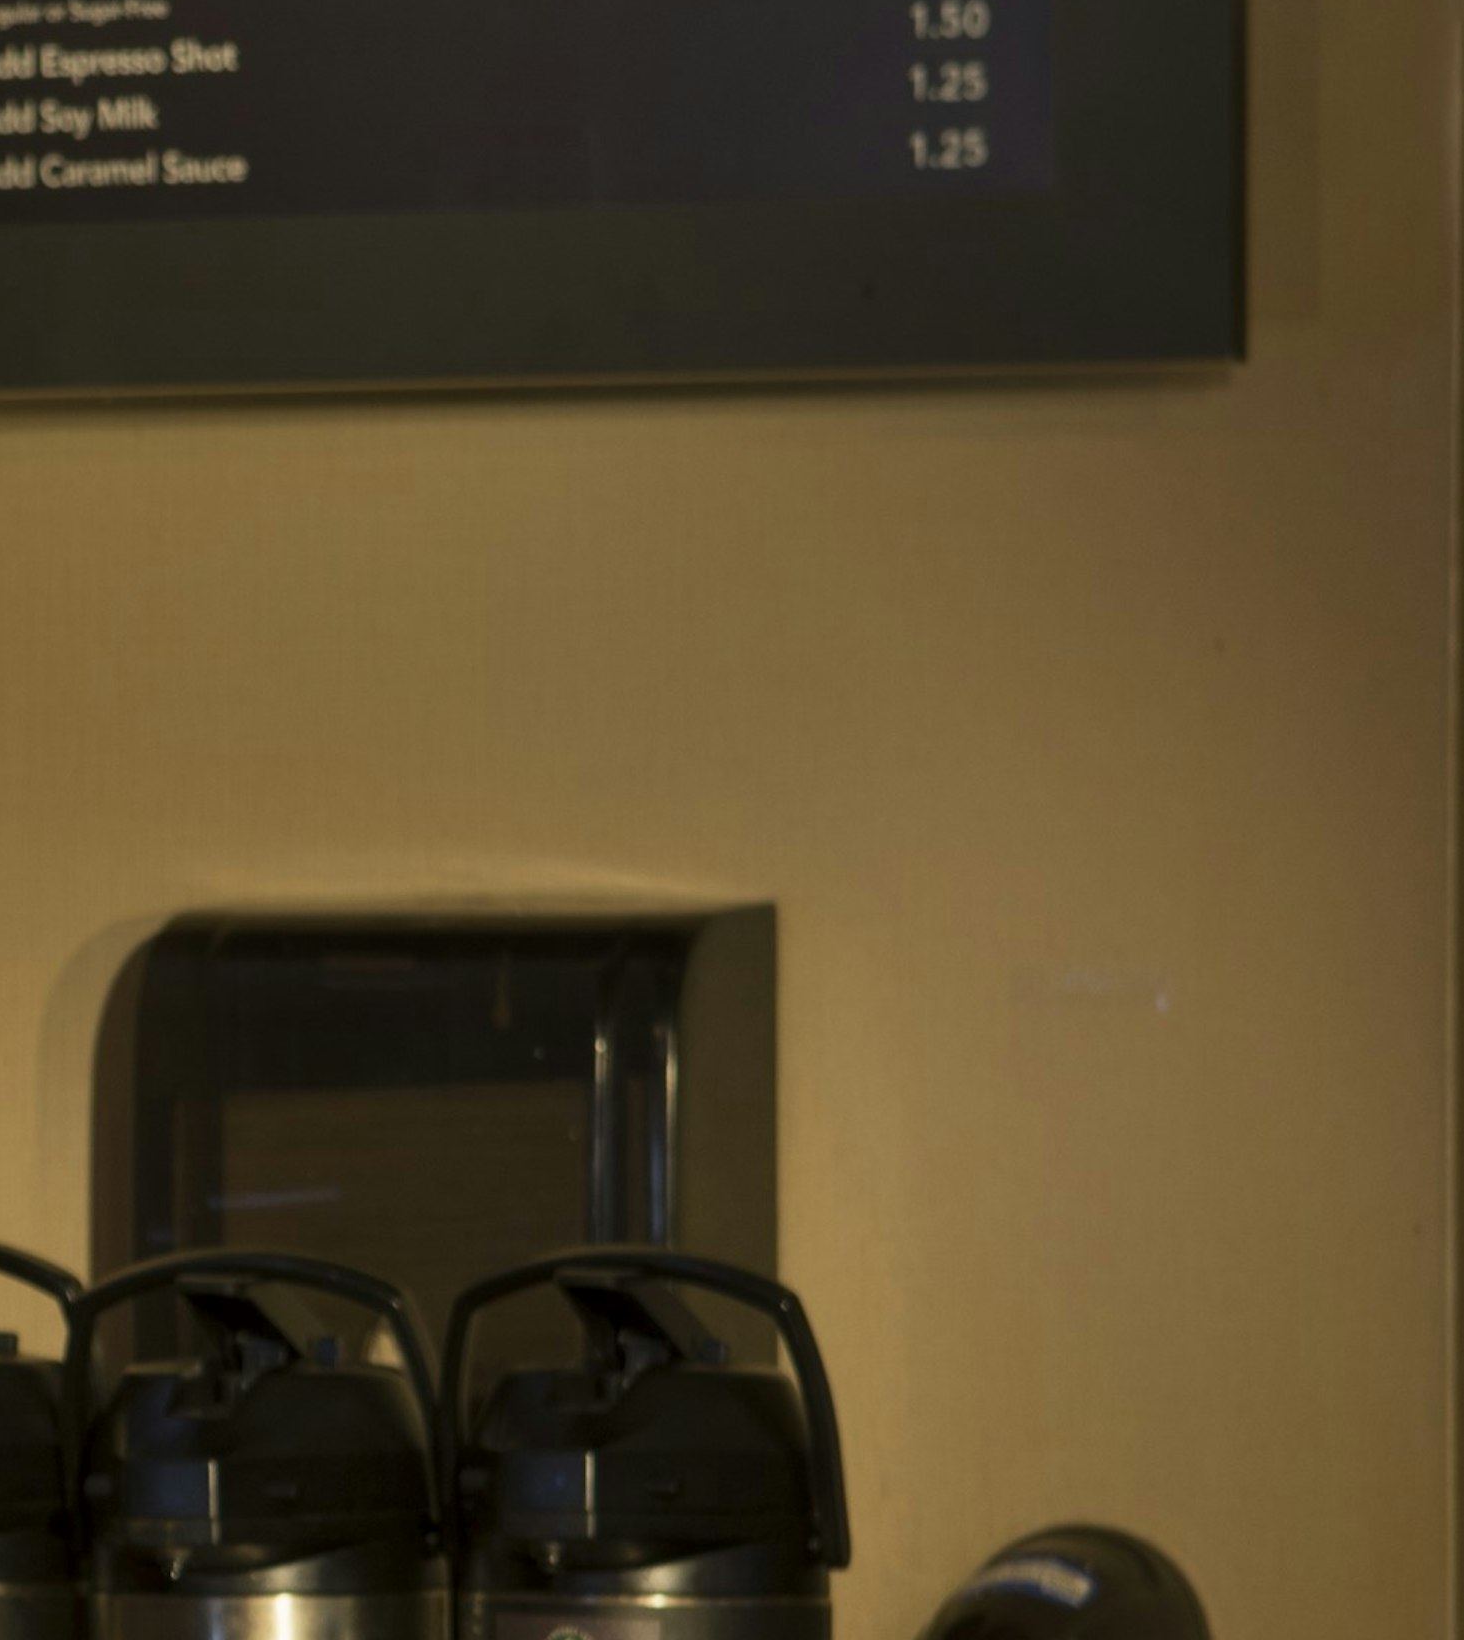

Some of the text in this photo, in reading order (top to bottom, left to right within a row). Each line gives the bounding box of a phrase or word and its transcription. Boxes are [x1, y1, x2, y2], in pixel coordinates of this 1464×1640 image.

[41, 43, 167, 85] Espresso
[171, 38, 238, 73] Shot
[909, 61, 987, 101] 1.25
[41, 100, 93, 139] Soy
[97, 96, 158, 129] Milk
[41, 150, 158, 187] Caramel
[163, 149, 248, 184] Sauce
[910, 127, 987, 168] 1.25
